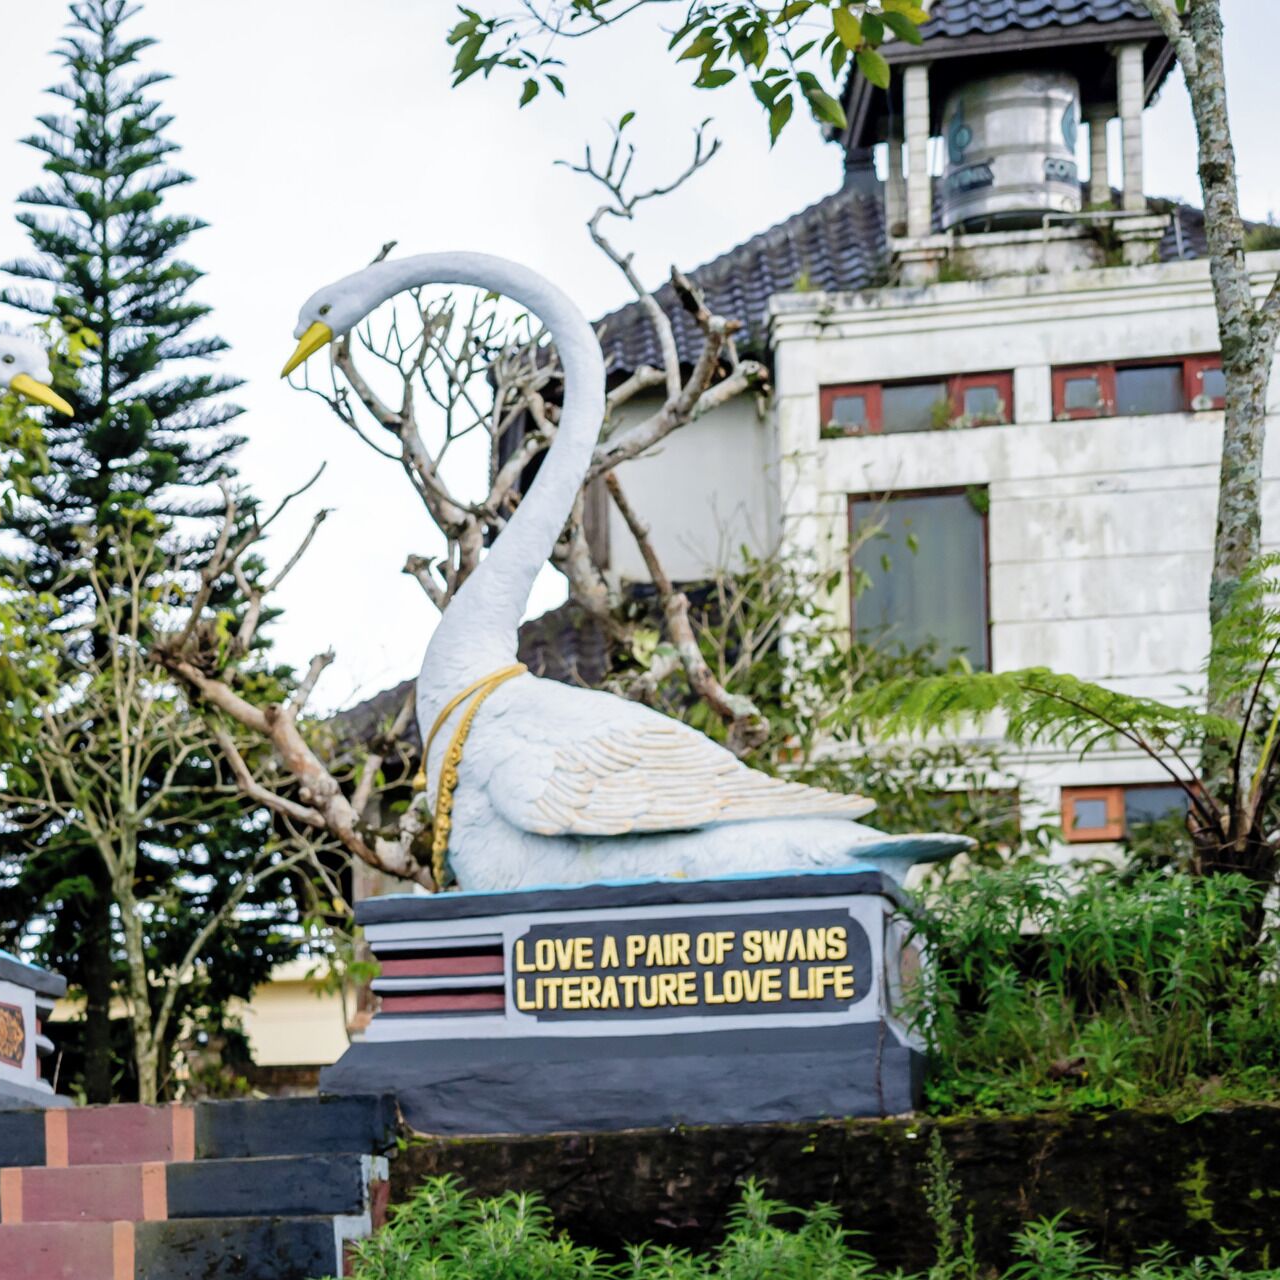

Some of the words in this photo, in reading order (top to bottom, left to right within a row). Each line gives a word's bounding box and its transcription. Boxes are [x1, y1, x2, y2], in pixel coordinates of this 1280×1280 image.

[516, 937, 594, 972] LOVE
[601, 934, 619, 969] A
[626, 932, 690, 968] PAIR
[696, 931, 735, 965] OF
[742, 926, 848, 963] SWANS
[516, 971, 698, 1010] LITERATURE
[704, 967, 782, 1004] LOVE
[789, 964, 855, 999] LIFE
